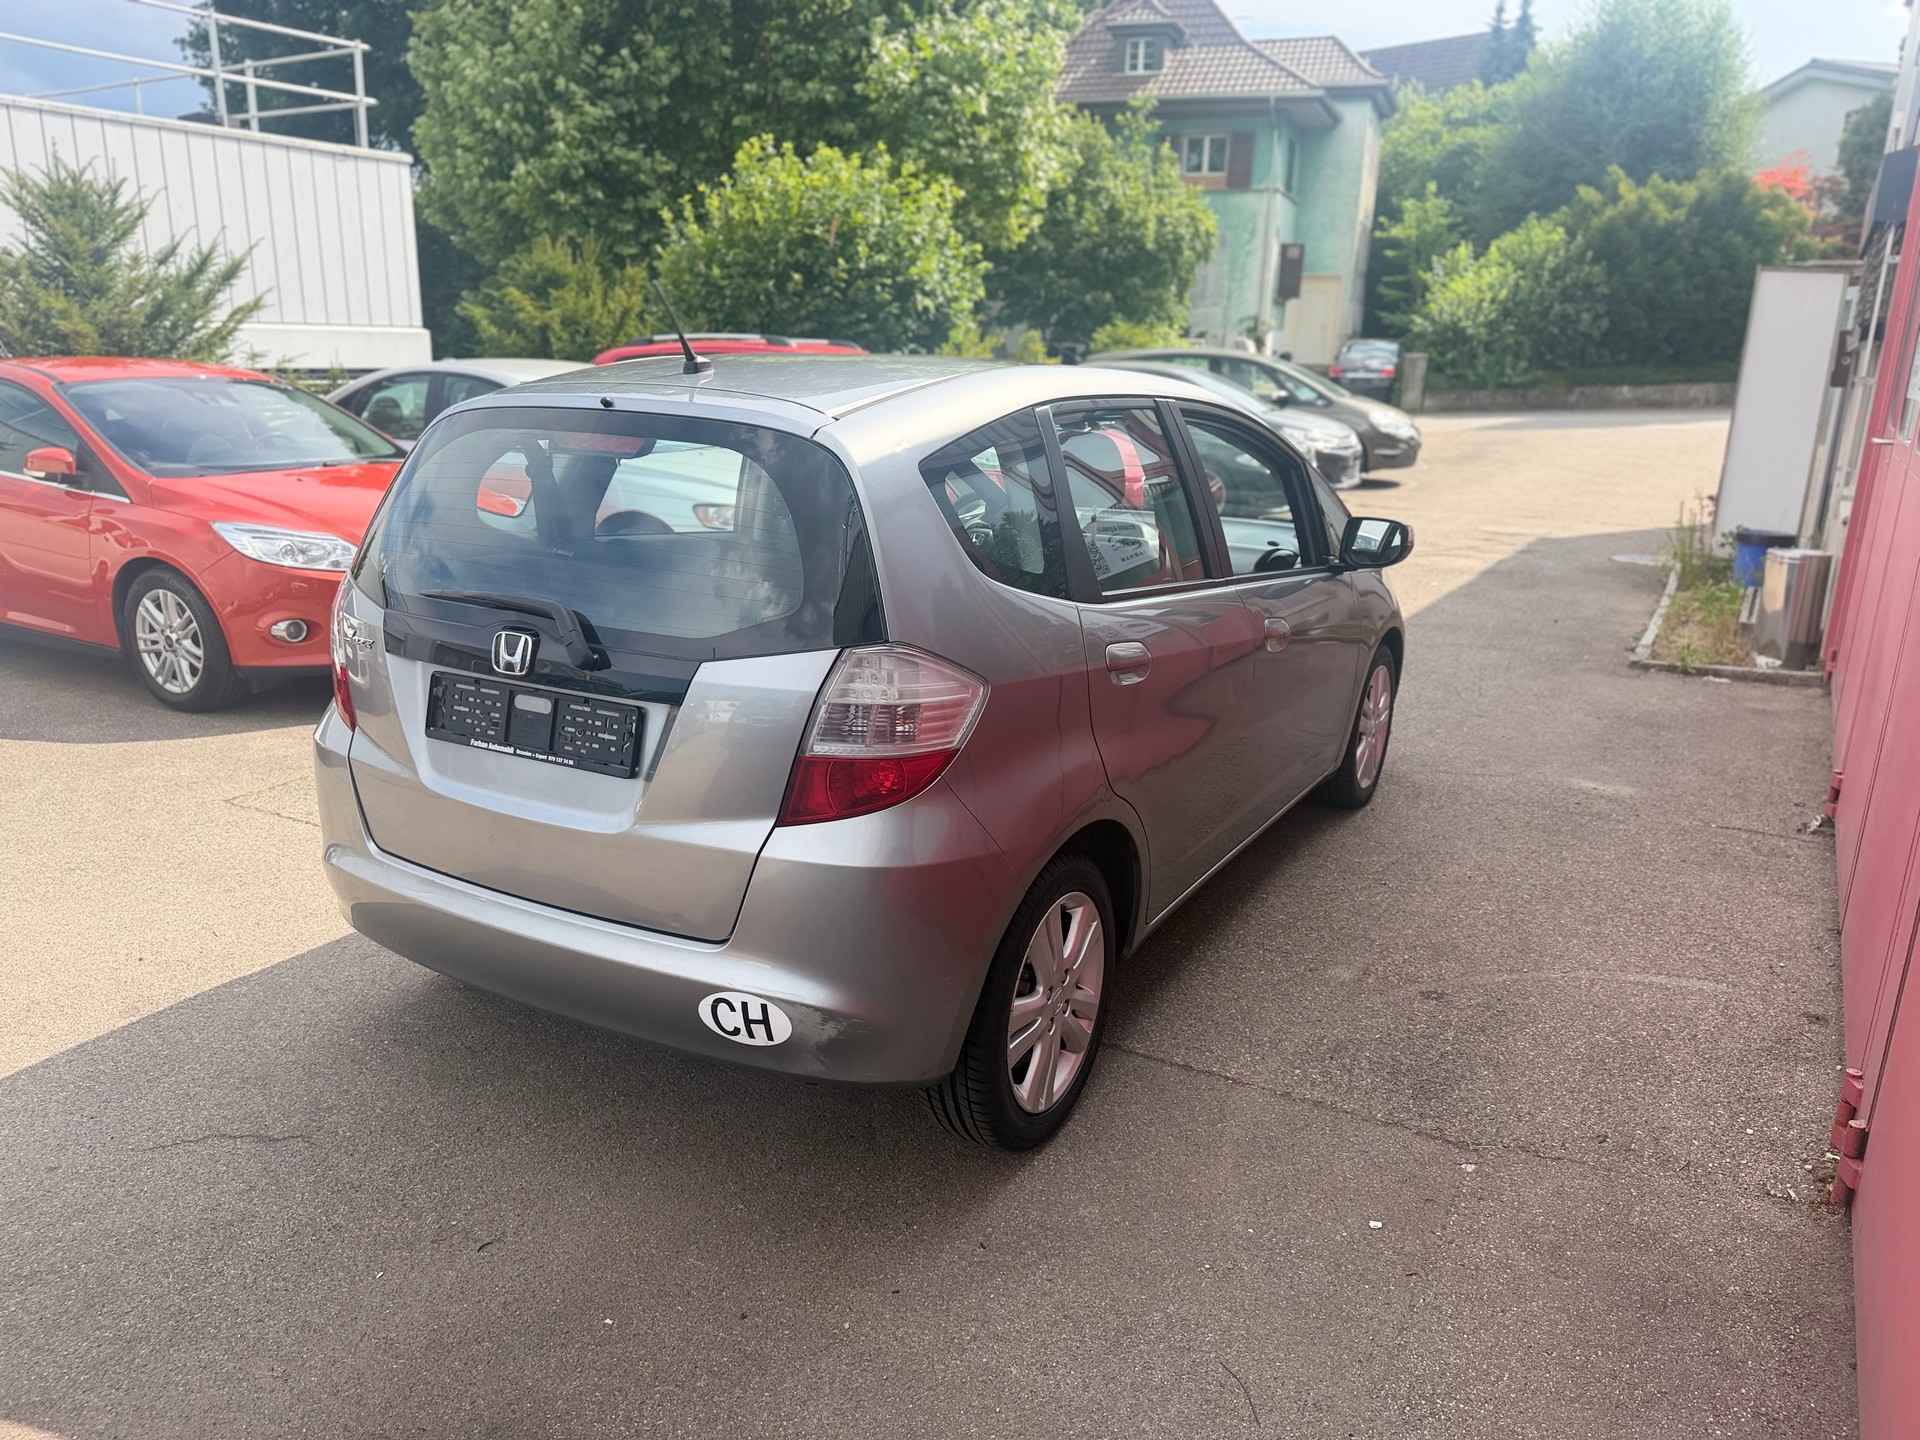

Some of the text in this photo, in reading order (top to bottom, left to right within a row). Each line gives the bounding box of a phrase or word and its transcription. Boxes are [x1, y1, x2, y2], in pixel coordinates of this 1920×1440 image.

[470, 738, 488, 749] Farhan
[488, 742, 515, 754] Automobil
[711, 997, 774, 1042] CH
